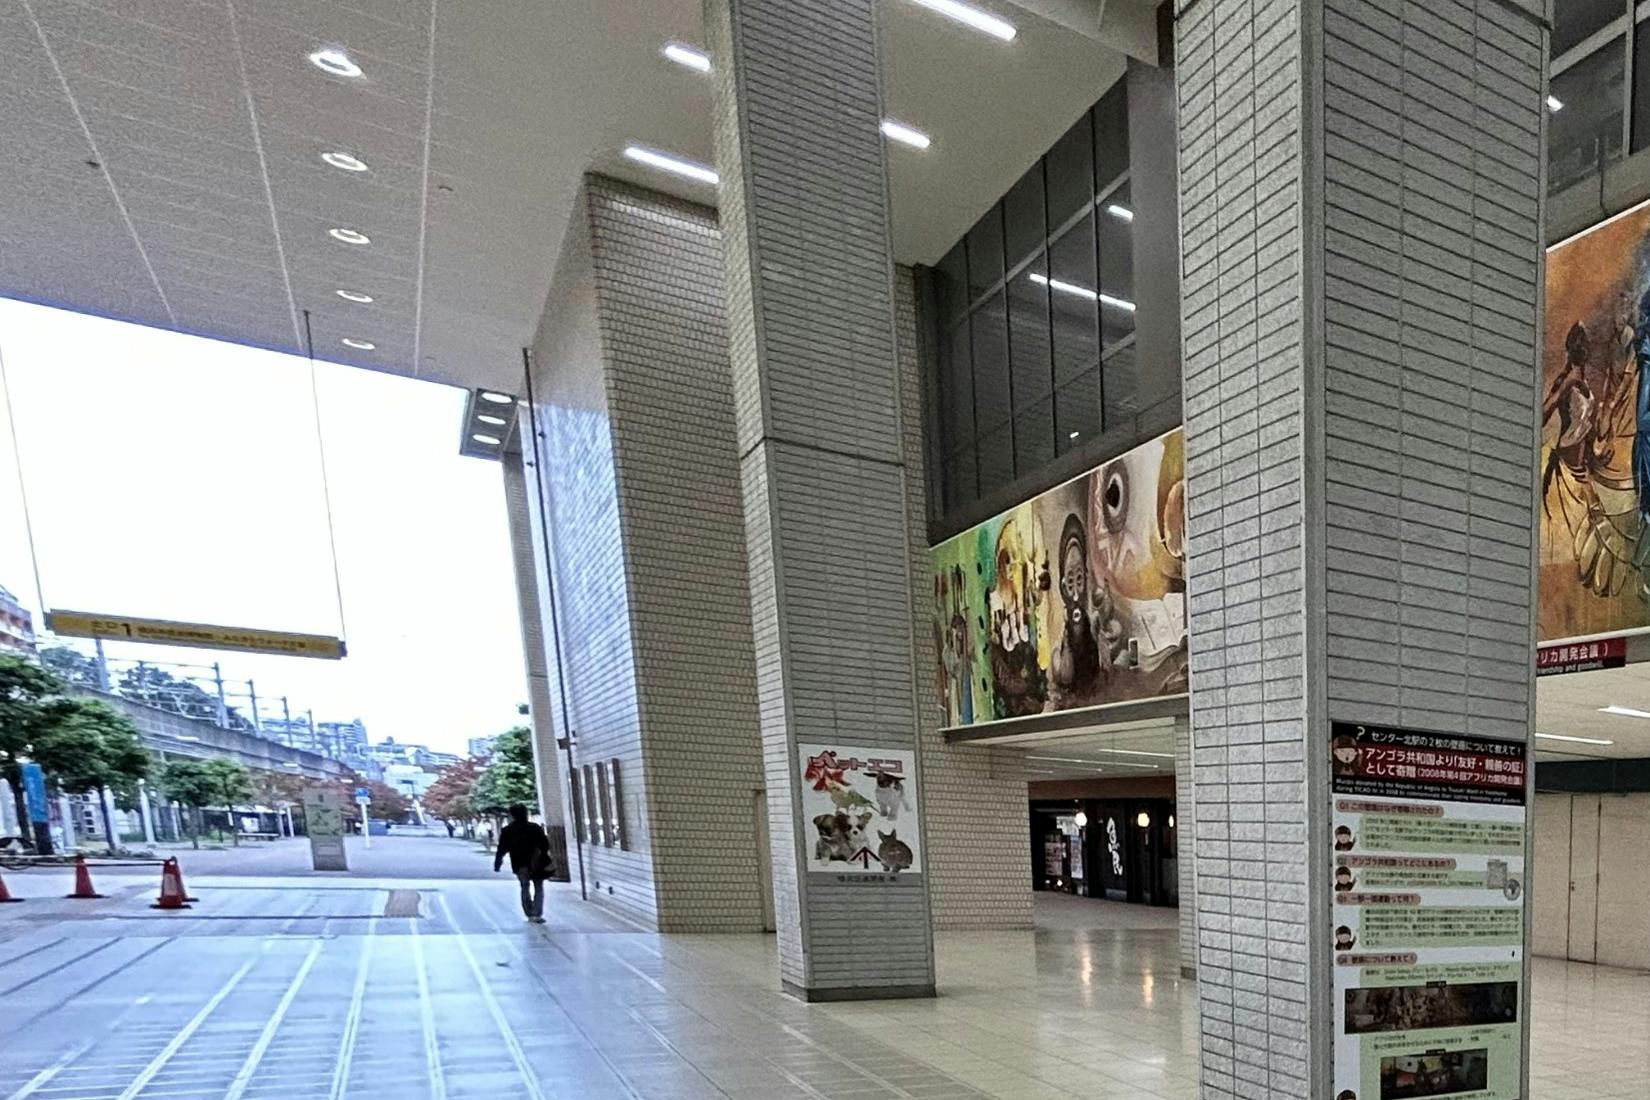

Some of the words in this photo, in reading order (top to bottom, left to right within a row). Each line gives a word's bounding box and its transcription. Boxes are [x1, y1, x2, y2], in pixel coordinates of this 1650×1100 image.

[1536, 642, 1608, 665] リカ開発会議)
